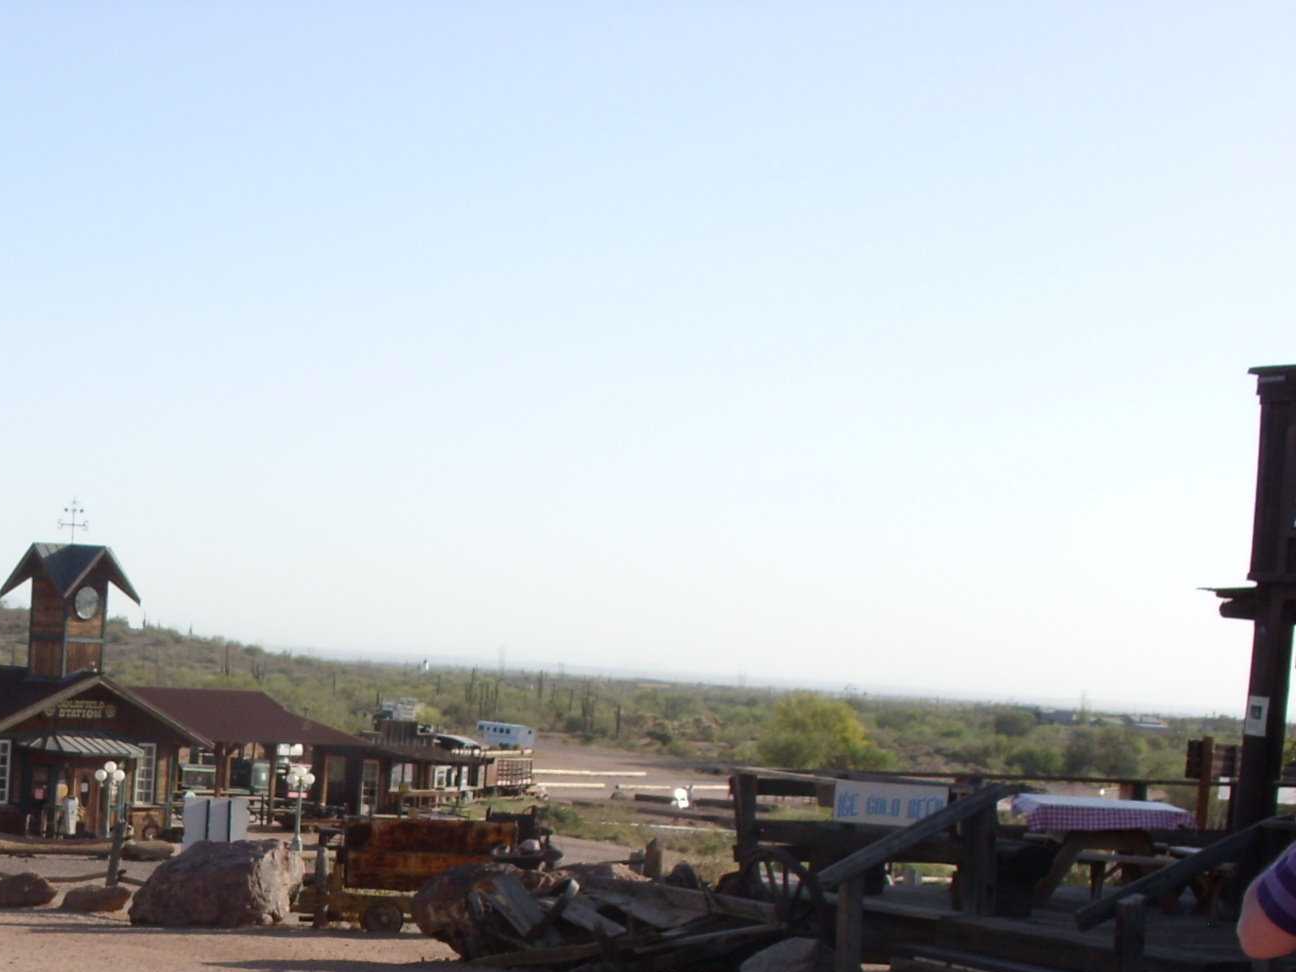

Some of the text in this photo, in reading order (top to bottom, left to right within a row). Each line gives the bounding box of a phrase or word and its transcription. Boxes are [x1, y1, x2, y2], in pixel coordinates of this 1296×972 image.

[58, 708, 102, 718] STATION
[836, 790, 860, 818] ICE
[866, 794, 901, 817] COLD
